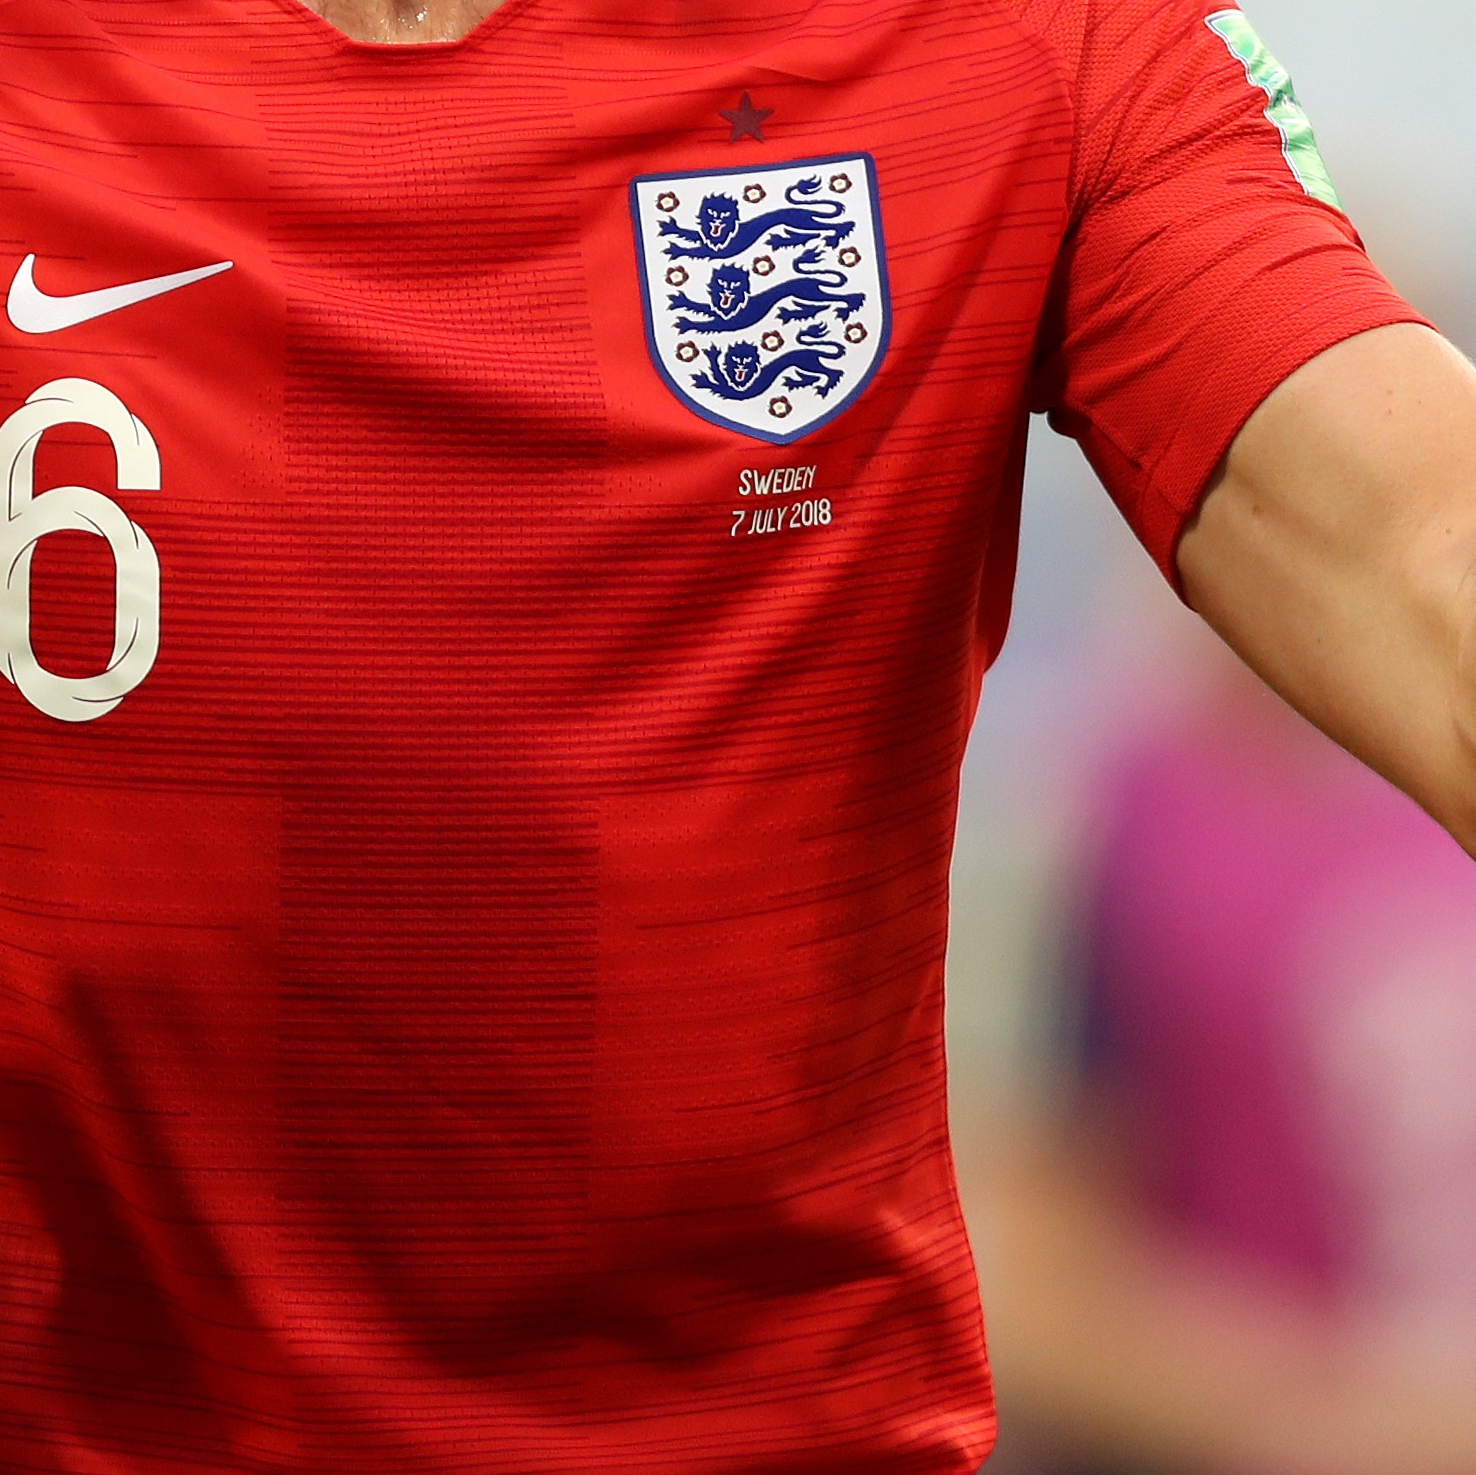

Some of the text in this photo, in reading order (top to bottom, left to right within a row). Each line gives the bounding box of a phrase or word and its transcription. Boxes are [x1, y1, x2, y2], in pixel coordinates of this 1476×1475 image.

[738, 464, 817, 496] SWEDEN
[730, 497, 832, 537] 7 JULY 2018
